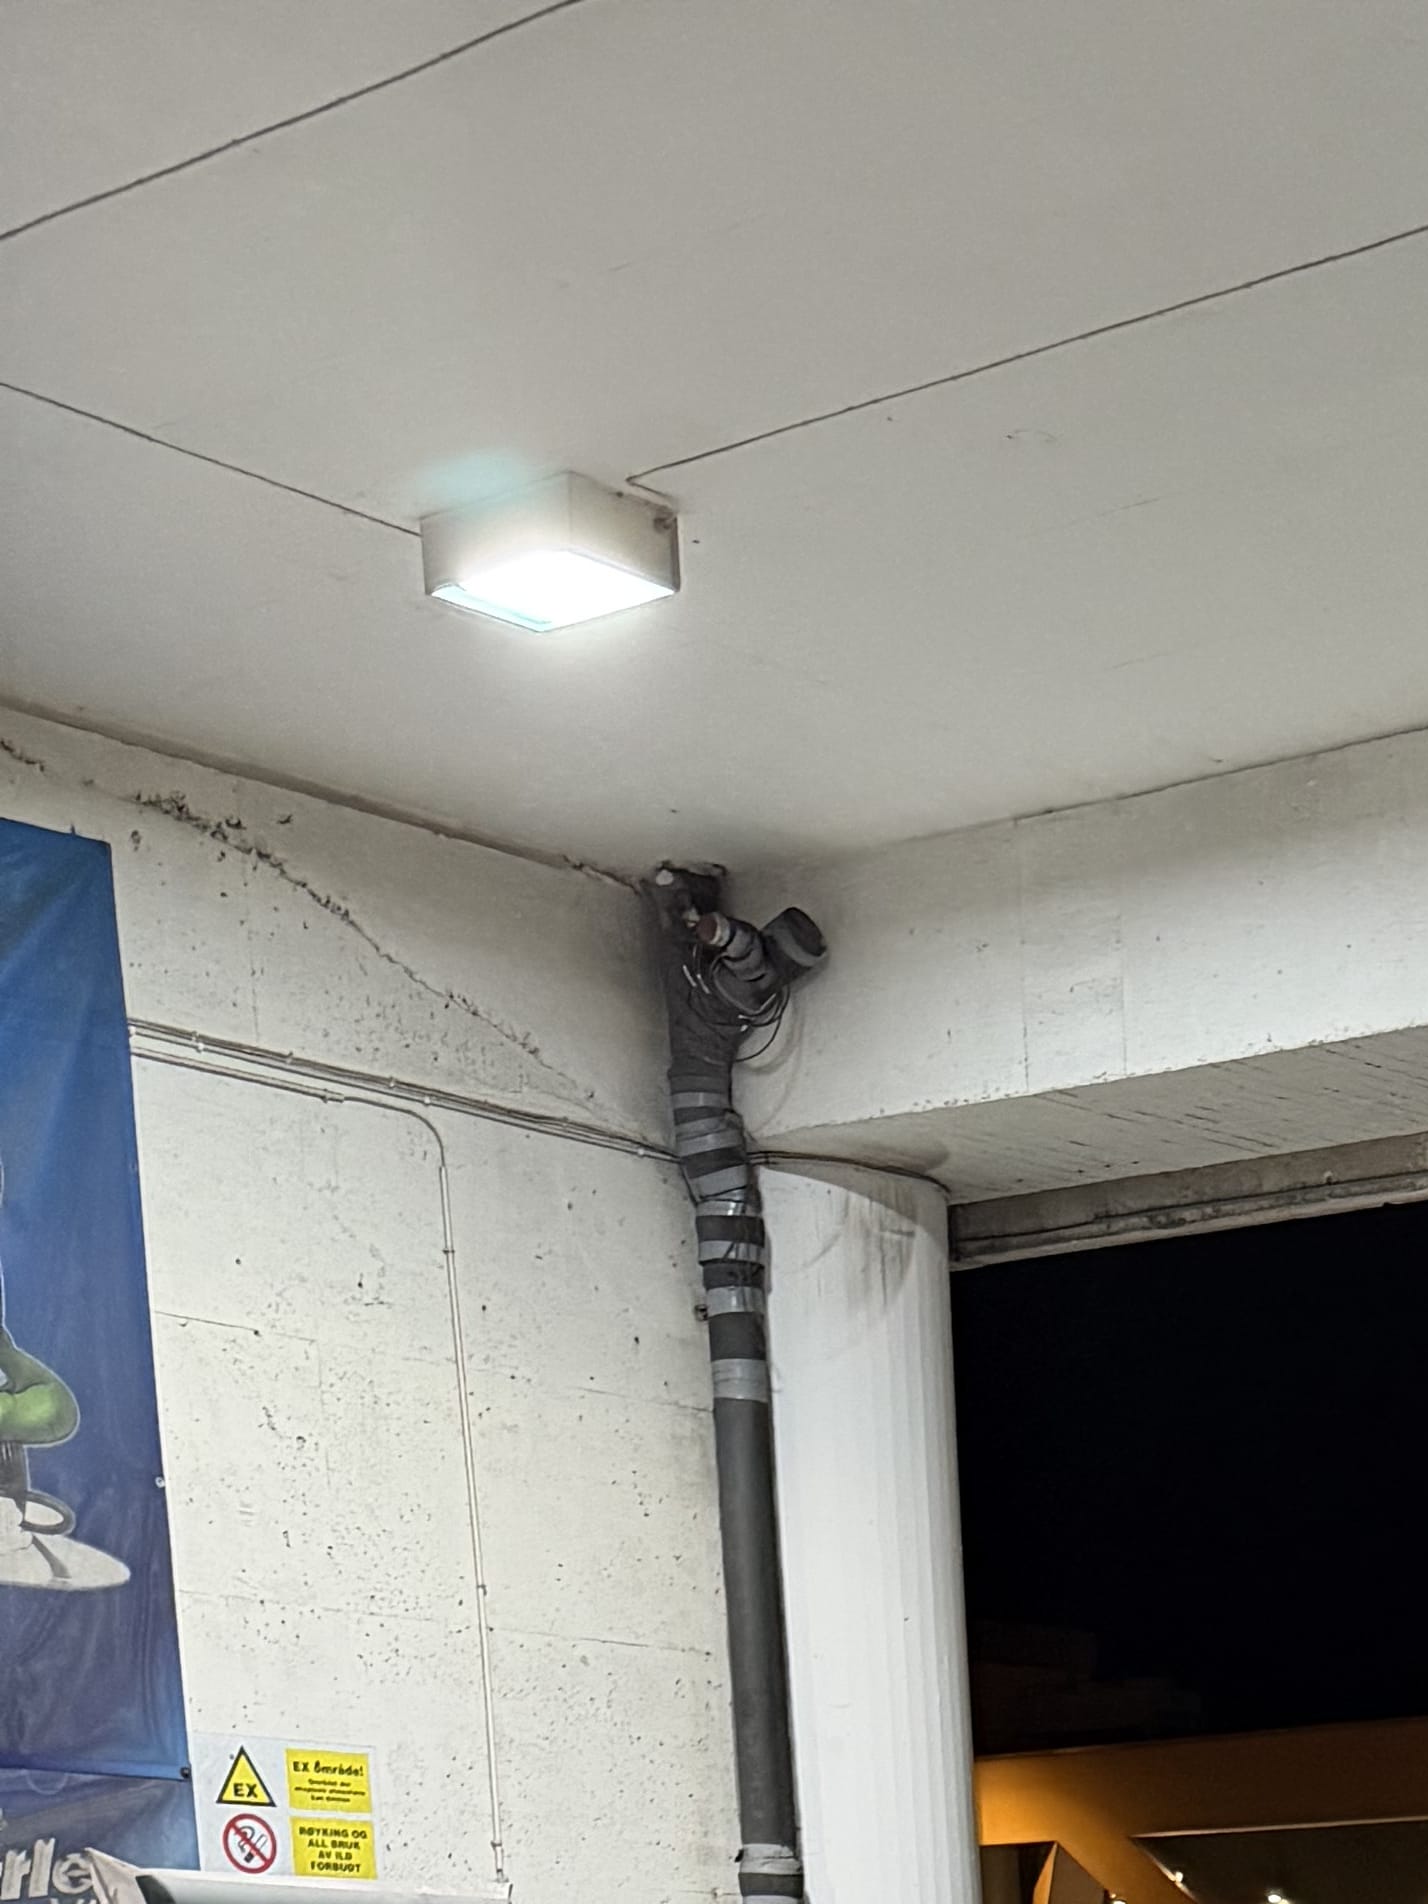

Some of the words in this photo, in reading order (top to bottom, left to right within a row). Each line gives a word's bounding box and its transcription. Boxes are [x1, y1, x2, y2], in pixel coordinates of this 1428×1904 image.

[293, 1761, 310, 1772] EX
[233, 1783, 258, 1798] EX
[351, 1829, 367, 1840] OG
[307, 1838, 329, 1849] ALL
[331, 1839, 361, 1850] BRUK
[318, 1850, 333, 1860] AV
